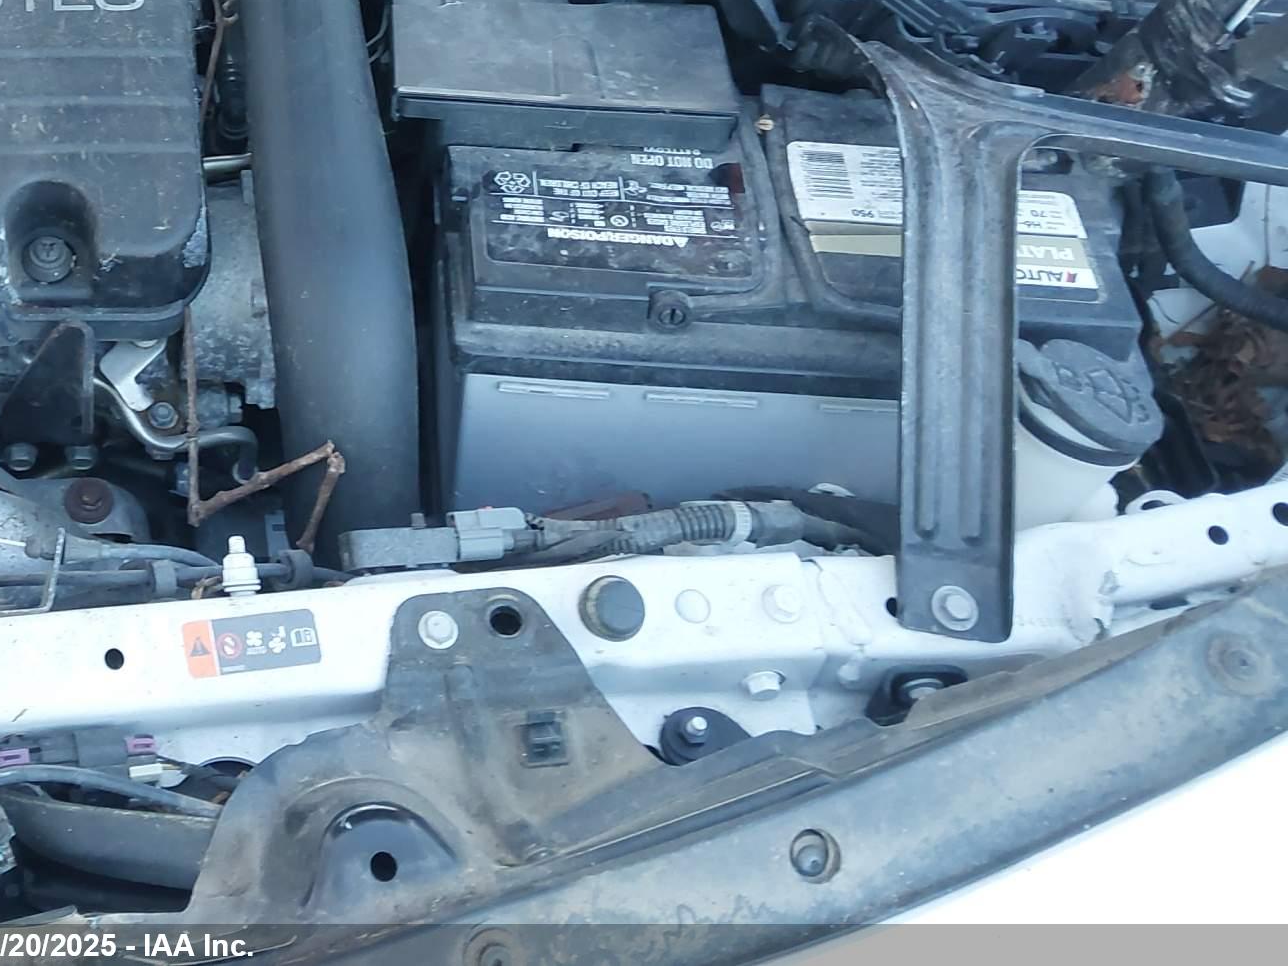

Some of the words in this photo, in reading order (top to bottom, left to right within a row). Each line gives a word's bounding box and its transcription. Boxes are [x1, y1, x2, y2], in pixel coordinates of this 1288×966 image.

[630, 154, 665, 166] OPEN
[667, 156, 693, 168] NOT
[694, 157, 713, 169] DO
